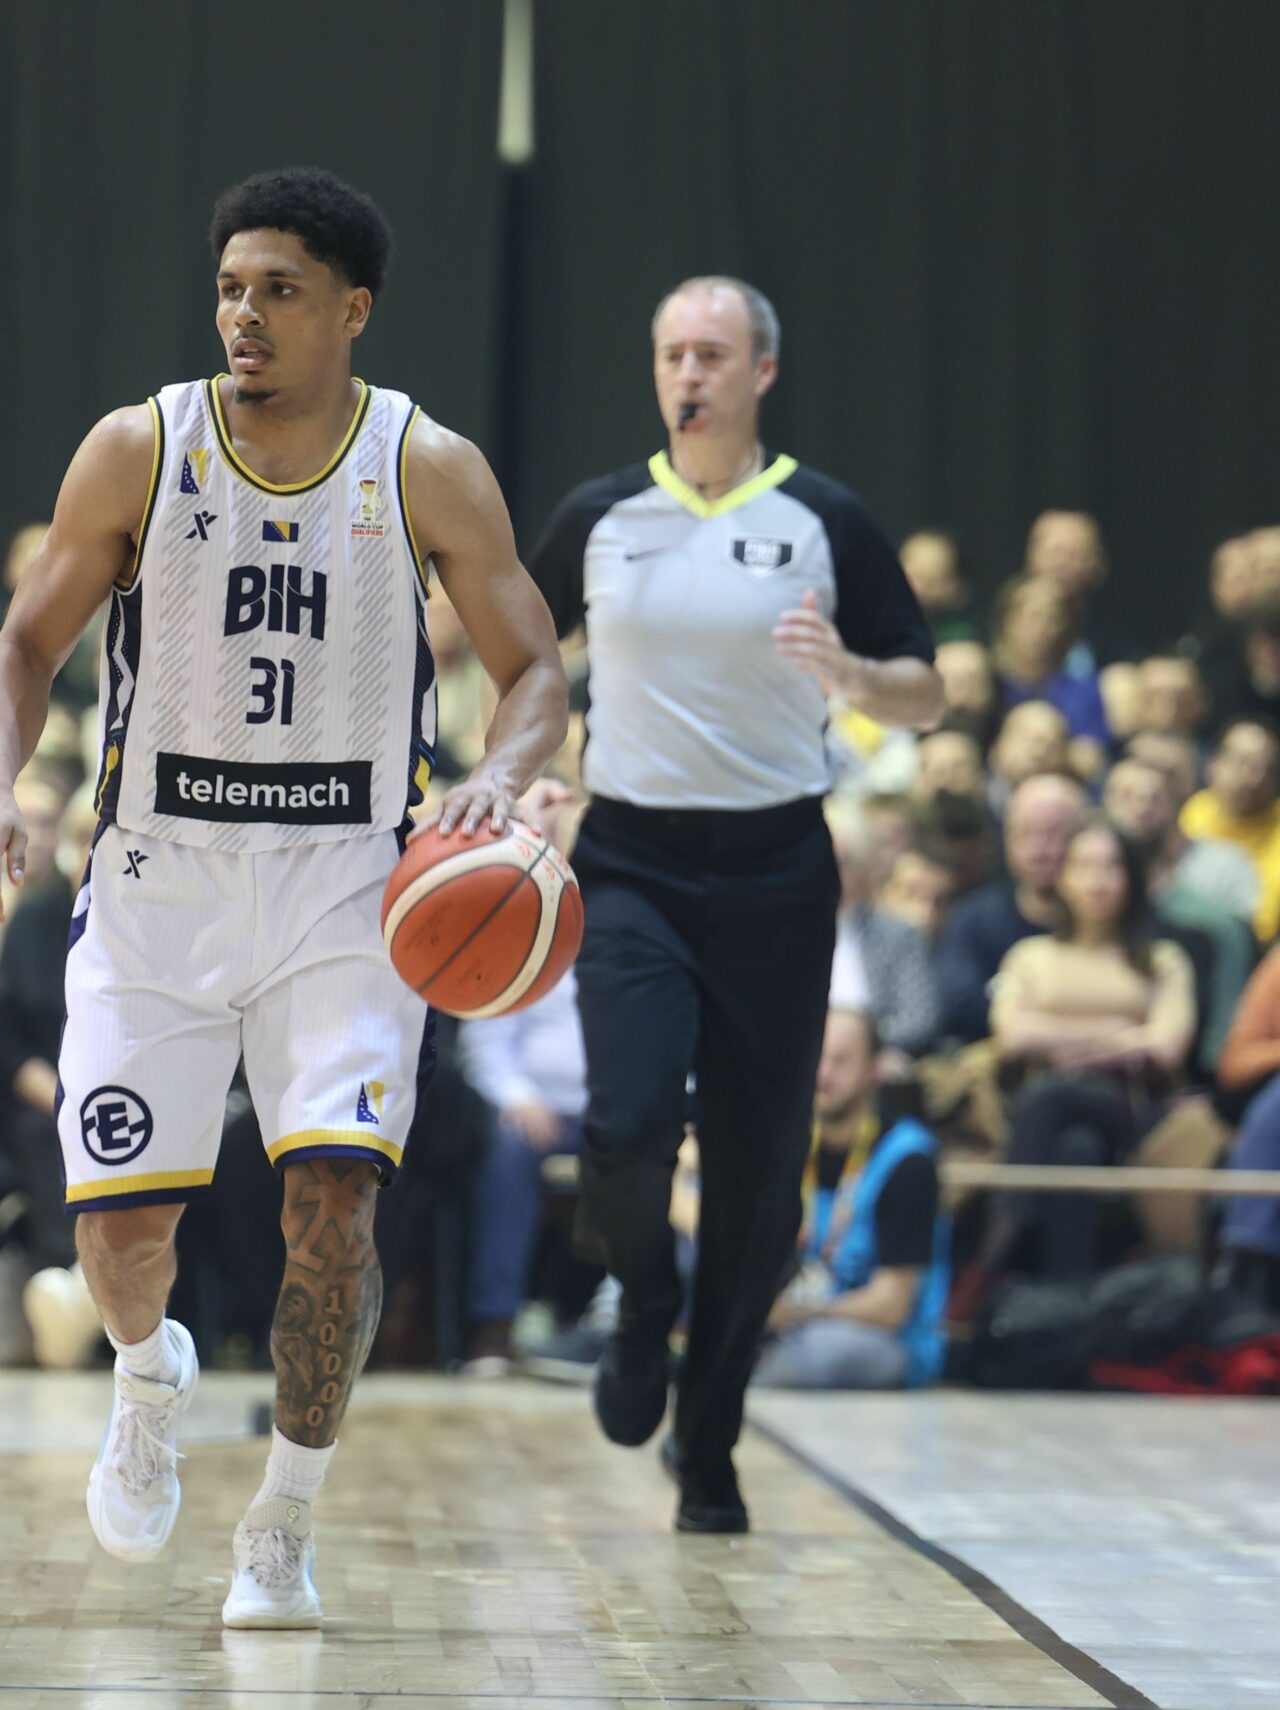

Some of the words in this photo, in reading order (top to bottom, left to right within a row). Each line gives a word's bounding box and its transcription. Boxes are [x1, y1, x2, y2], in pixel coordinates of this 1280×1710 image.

[224, 563, 327, 641] BIH
[246, 656, 296, 726] 31
[176, 771, 350, 808] telemach
